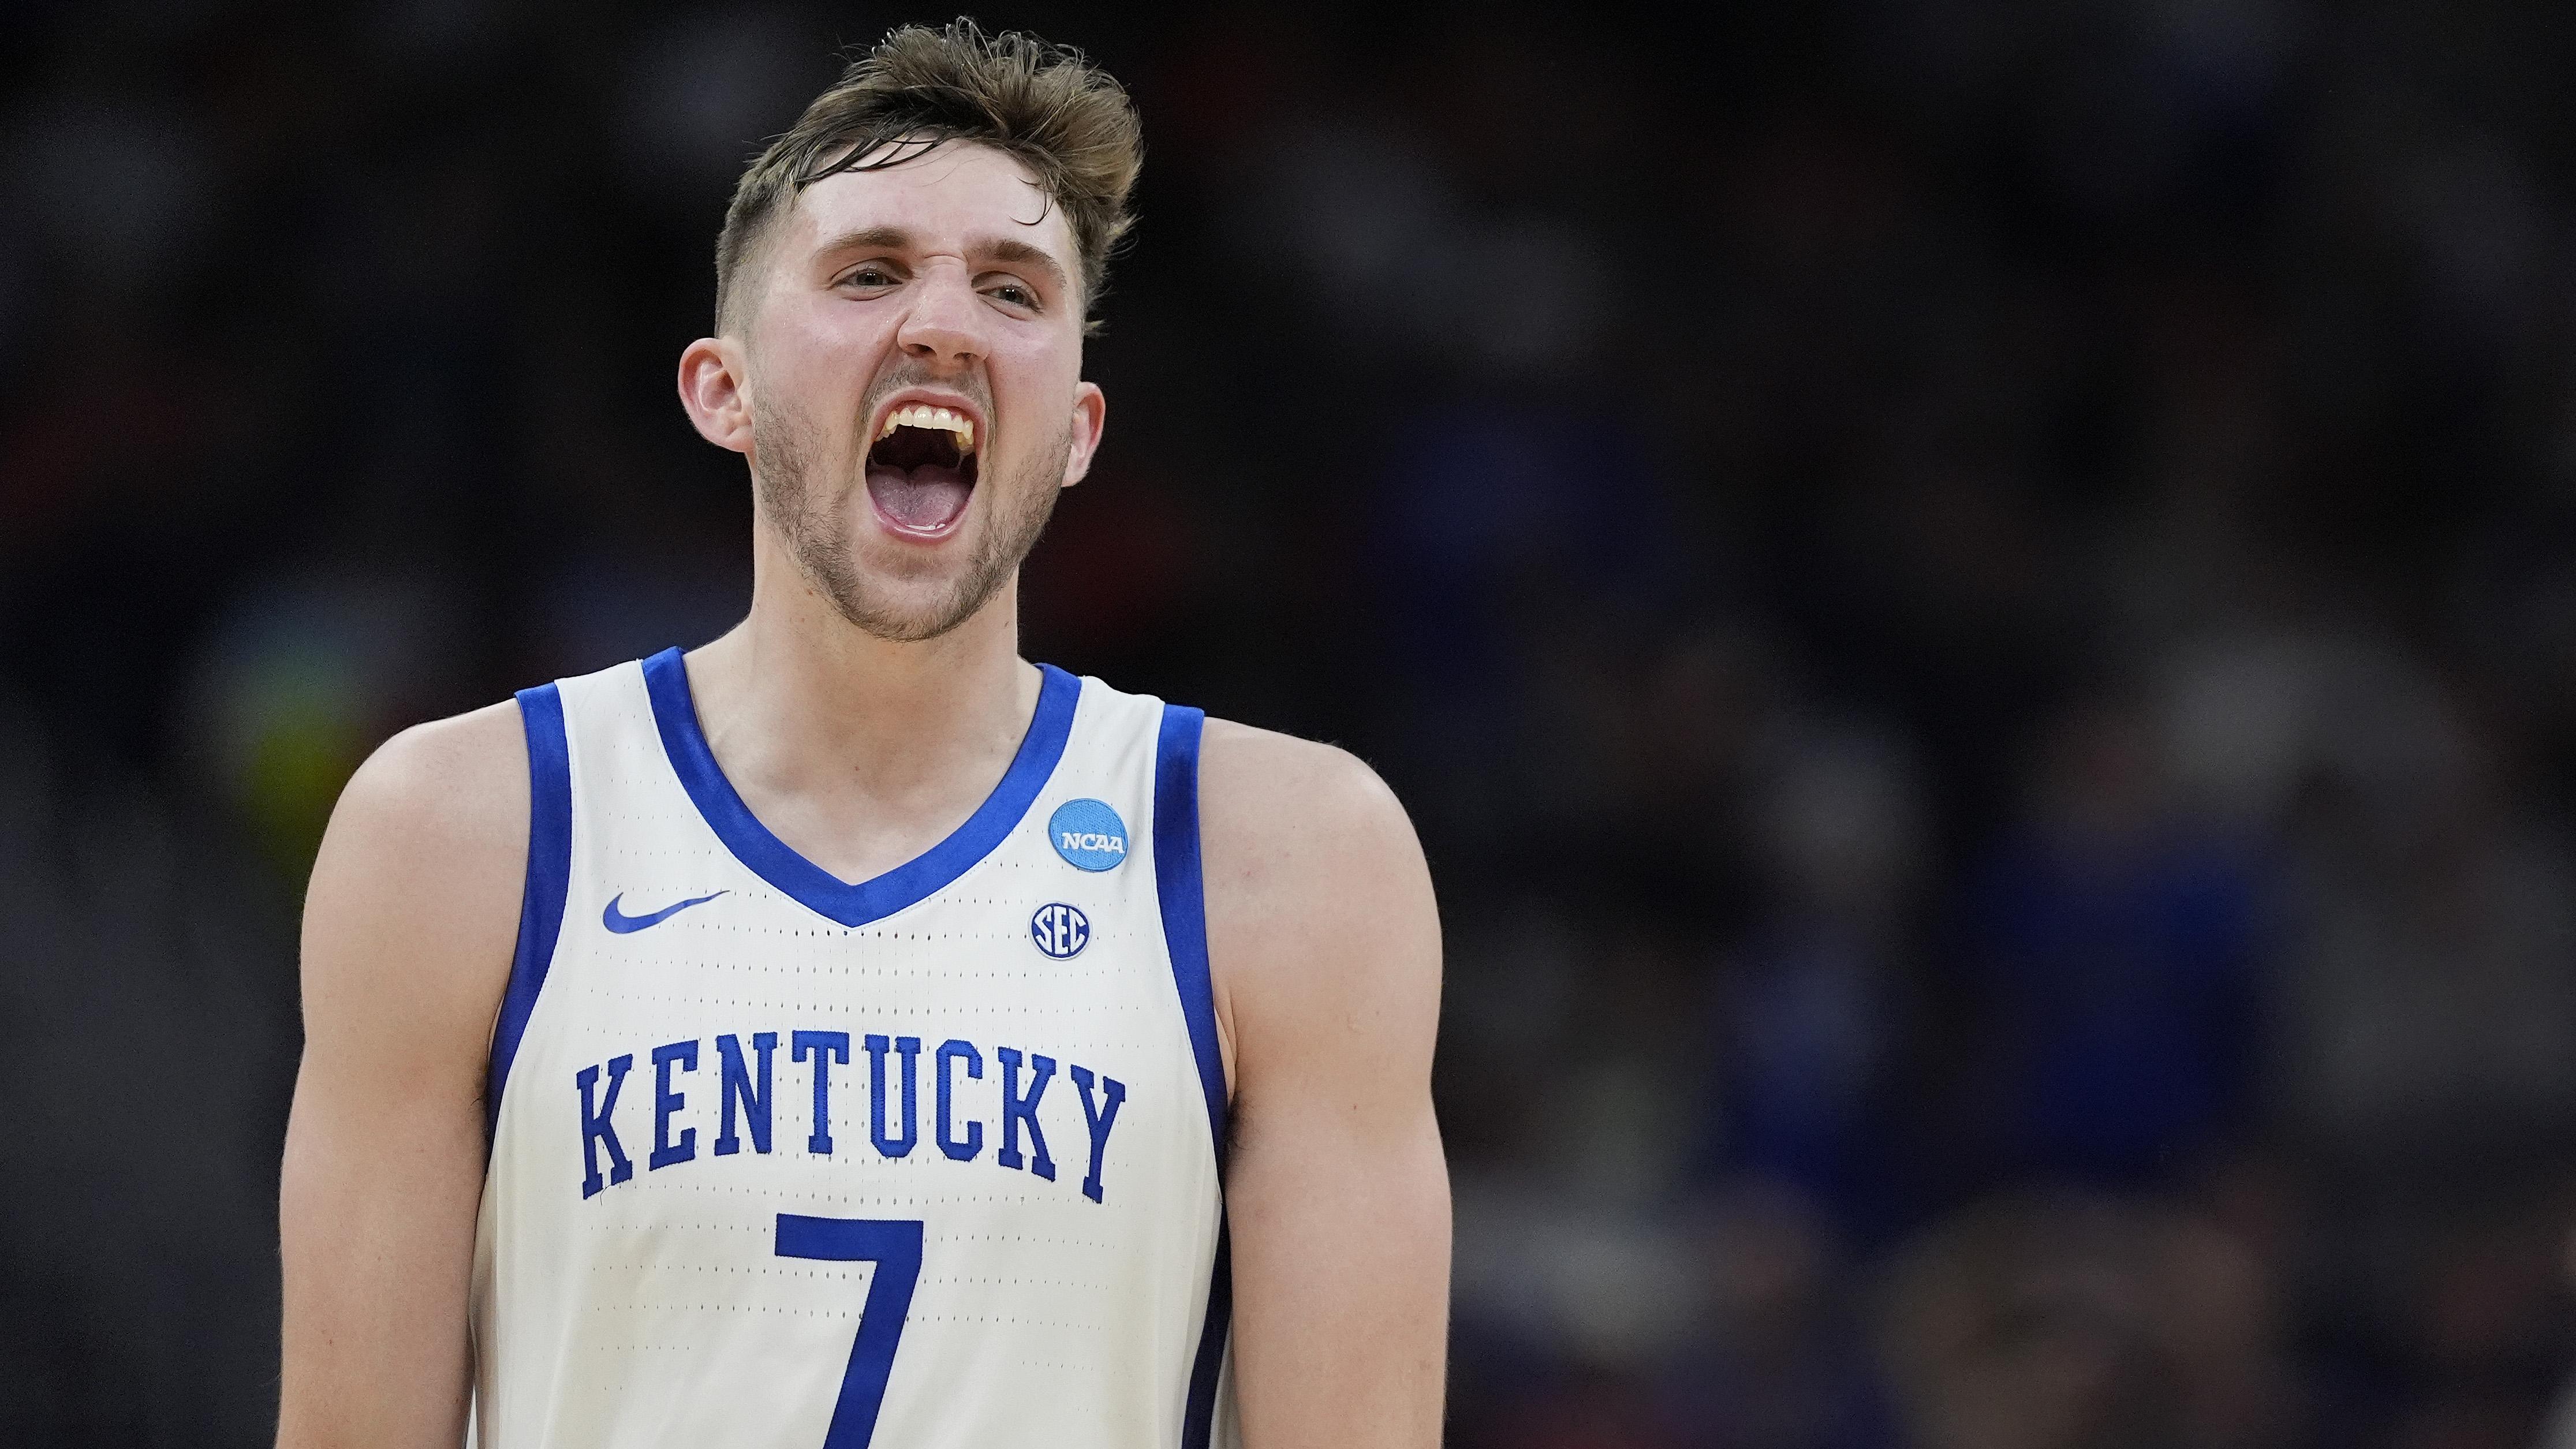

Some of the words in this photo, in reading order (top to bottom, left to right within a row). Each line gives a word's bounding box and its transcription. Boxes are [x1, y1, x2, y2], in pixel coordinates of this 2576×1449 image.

[1062, 832, 1125, 853] NCAA
[1034, 906, 1087, 955] SEC
[577, 1030, 1126, 1204] KENTUCKY
[774, 1213, 924, 1449] 7
